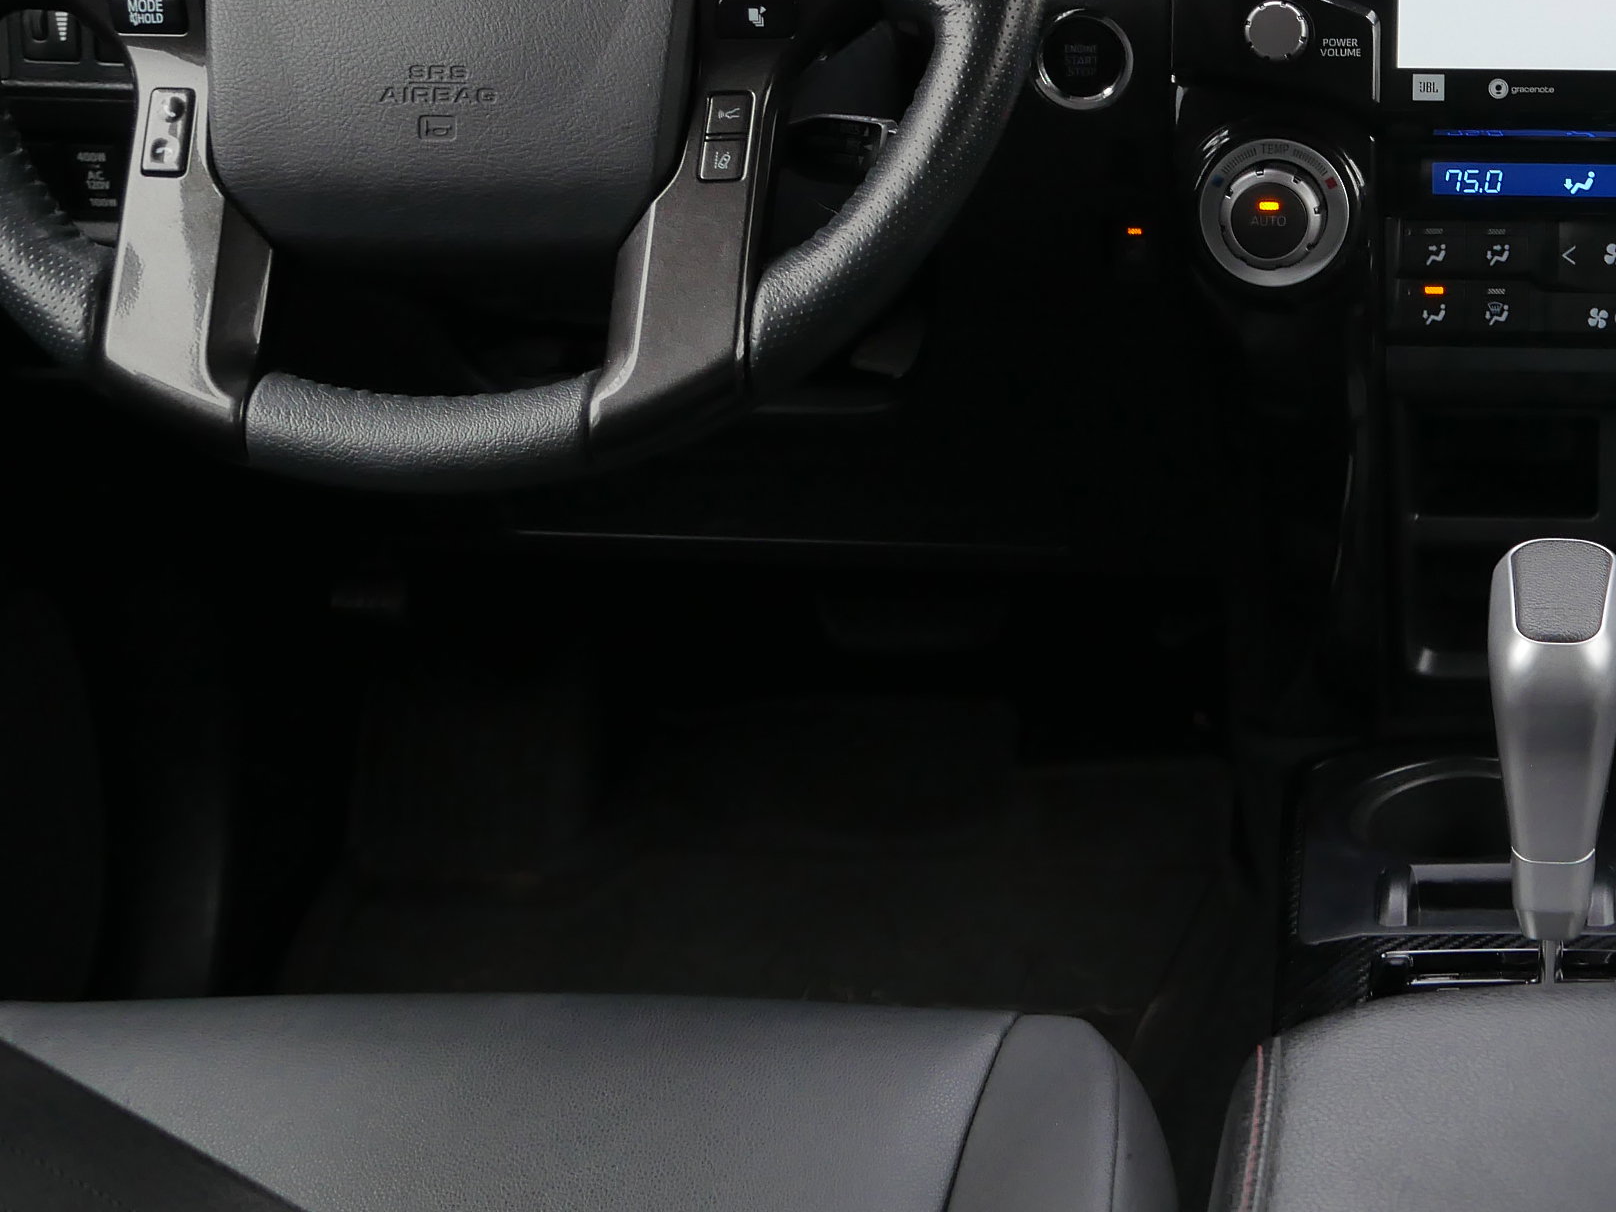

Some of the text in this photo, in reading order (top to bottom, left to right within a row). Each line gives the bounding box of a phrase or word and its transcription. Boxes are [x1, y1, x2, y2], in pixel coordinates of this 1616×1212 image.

[127, 0, 164, 13] MODE
[138, 12, 164, 25] HOLD
[1322, 38, 1359, 47] POWER
[1320, 47, 1362, 57] VOLUME
[1419, 80, 1440, 94] JBL
[1511, 85, 1555, 95] gracenote
[378, 86, 500, 105] AIRBAG
[1261, 143, 1290, 155] TEMP
[1445, 169, 1503, 194] 75.0
[1251, 215, 1287, 227] AUTO
